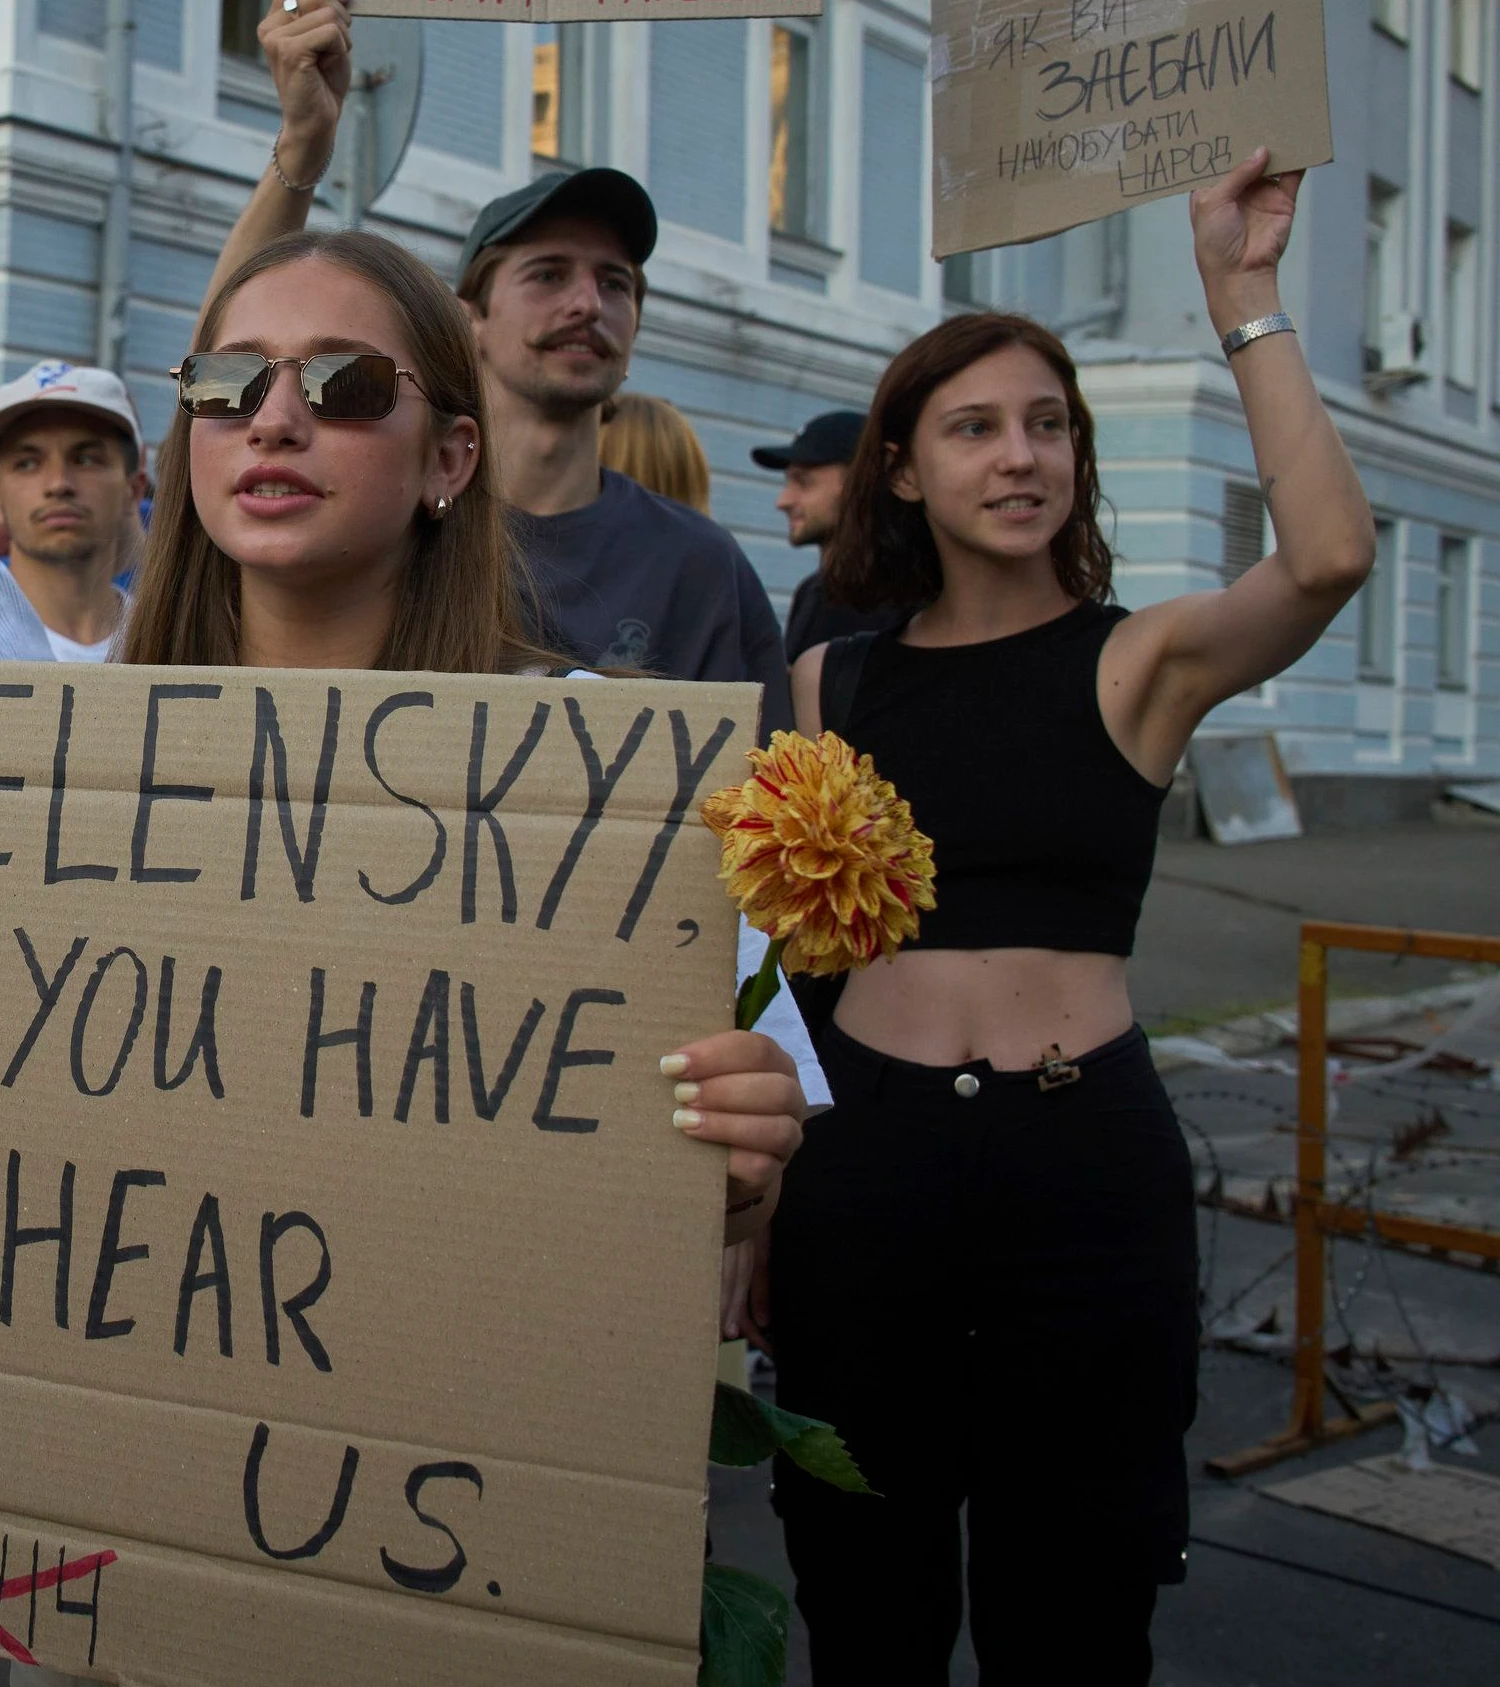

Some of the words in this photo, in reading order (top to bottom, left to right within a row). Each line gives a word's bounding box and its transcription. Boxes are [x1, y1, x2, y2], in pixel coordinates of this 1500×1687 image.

[989, 9, 1047, 70] ЯК
[1071, 0, 1127, 42] ВИ
[998, 109, 1198, 181] НАЙОБУВАТИ
[1117, 136, 1232, 192] НАРОД
[0, 926, 225, 1100] YOU
[300, 967, 626, 1134] HAVE
[242, 1421, 500, 1598] US.
